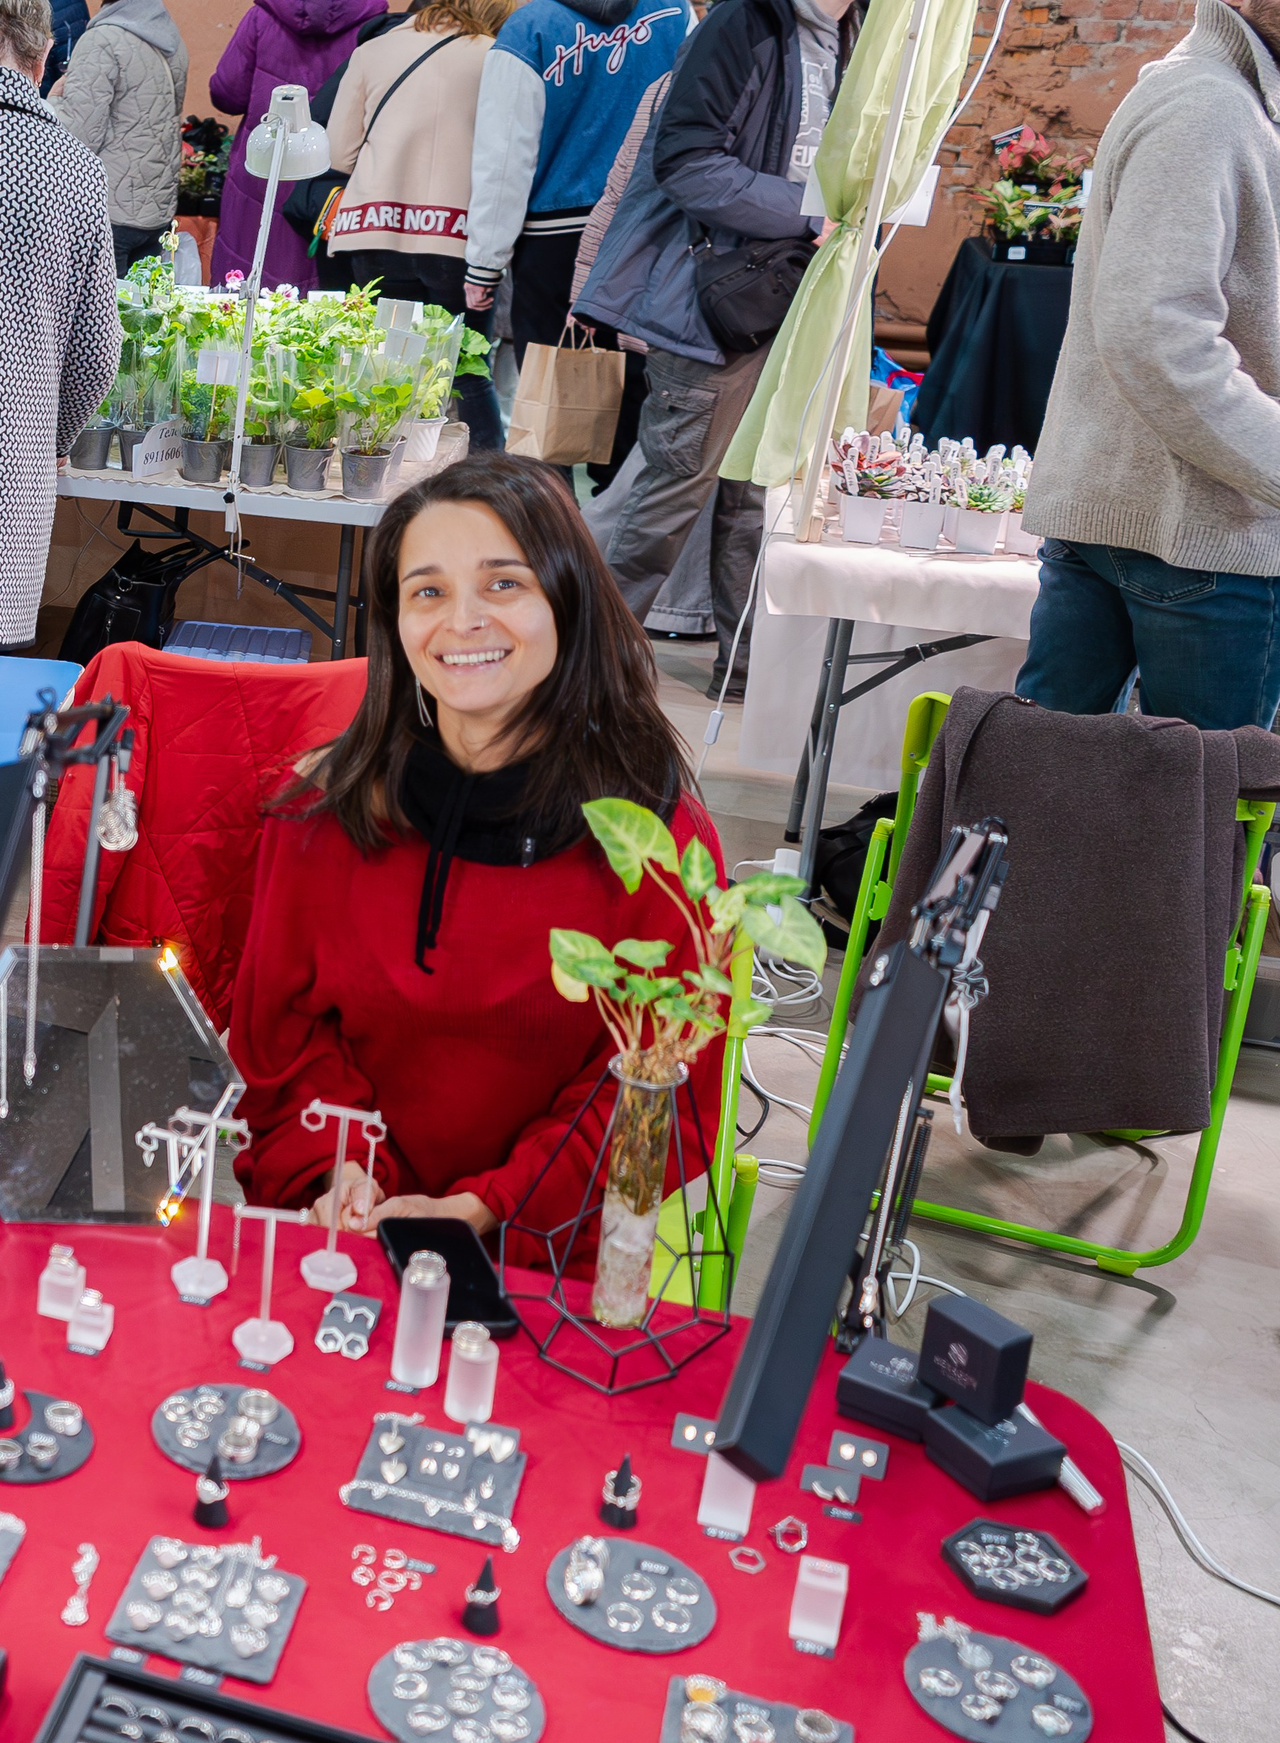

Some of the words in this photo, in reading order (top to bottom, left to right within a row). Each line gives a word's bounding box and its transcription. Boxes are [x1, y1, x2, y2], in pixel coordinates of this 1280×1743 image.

[543, 7, 682, 86] Hugo
[336, 209, 363, 232] WE
[363, 205, 402, 228] ARE
[404, 208, 451, 232] NOT
[143, 446, 183, 465] 8911606
